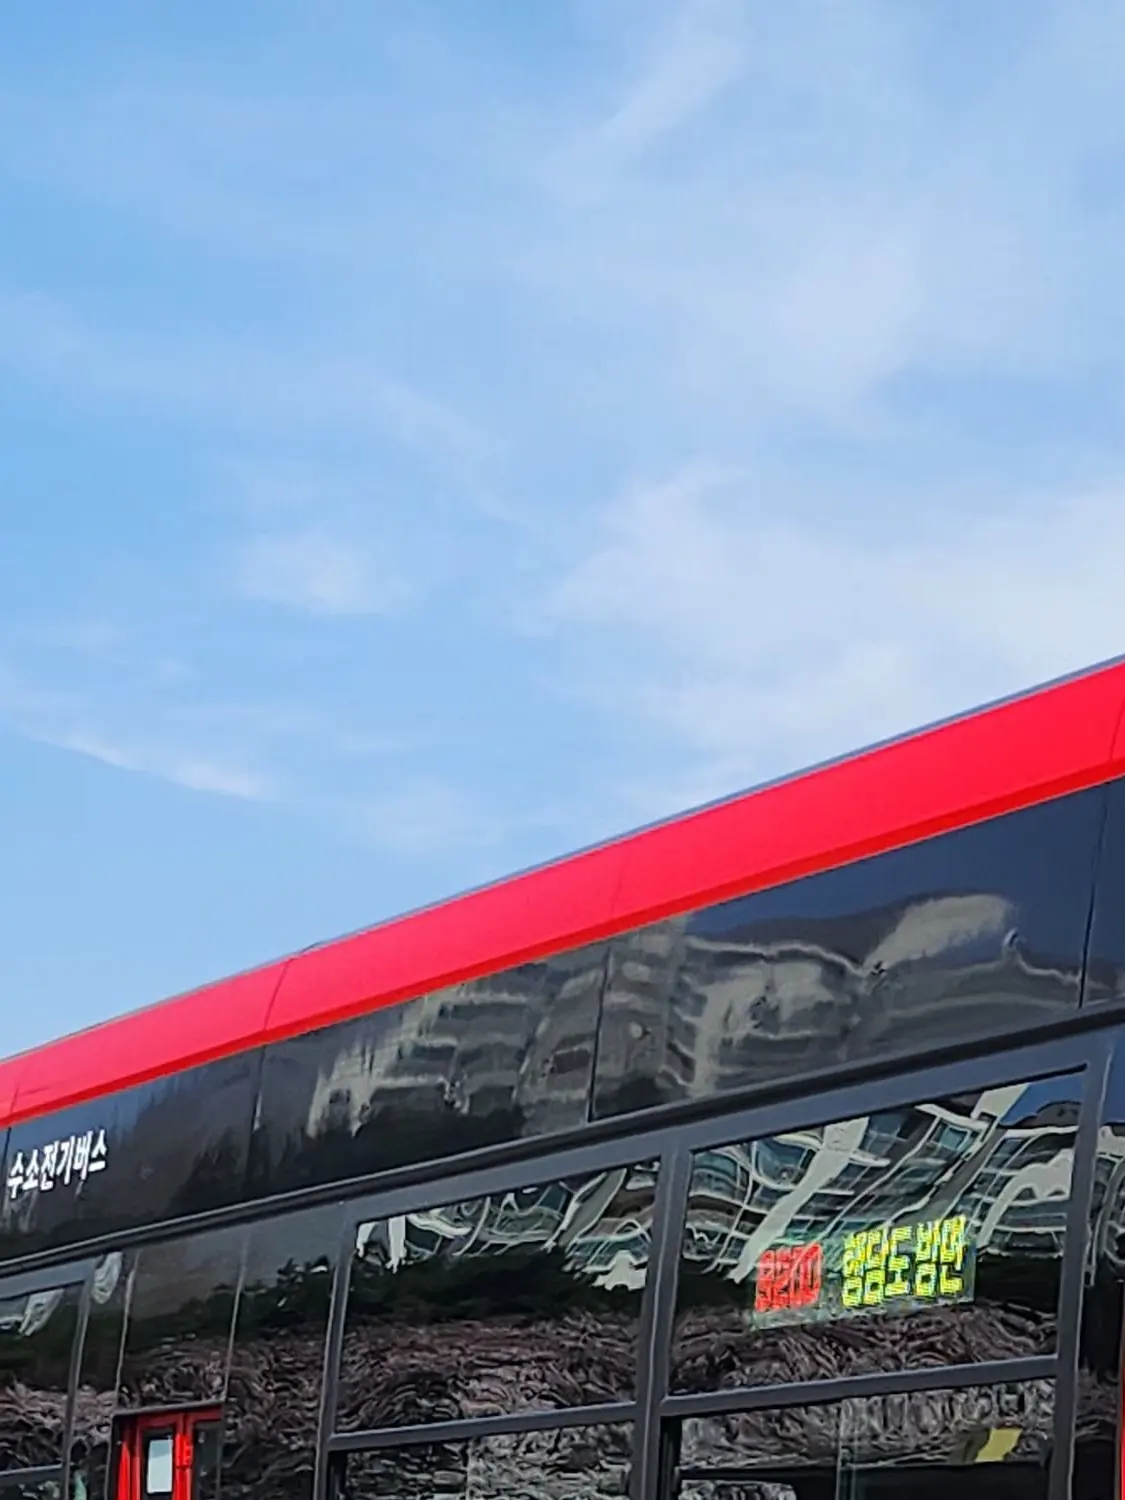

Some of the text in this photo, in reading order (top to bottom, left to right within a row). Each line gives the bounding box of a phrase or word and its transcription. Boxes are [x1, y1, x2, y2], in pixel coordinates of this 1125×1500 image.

[6, 1128, 108, 1199] 수소전기버스
[842, 1226, 911, 1307] 행담도
[915, 1214, 966, 1297] 방면
